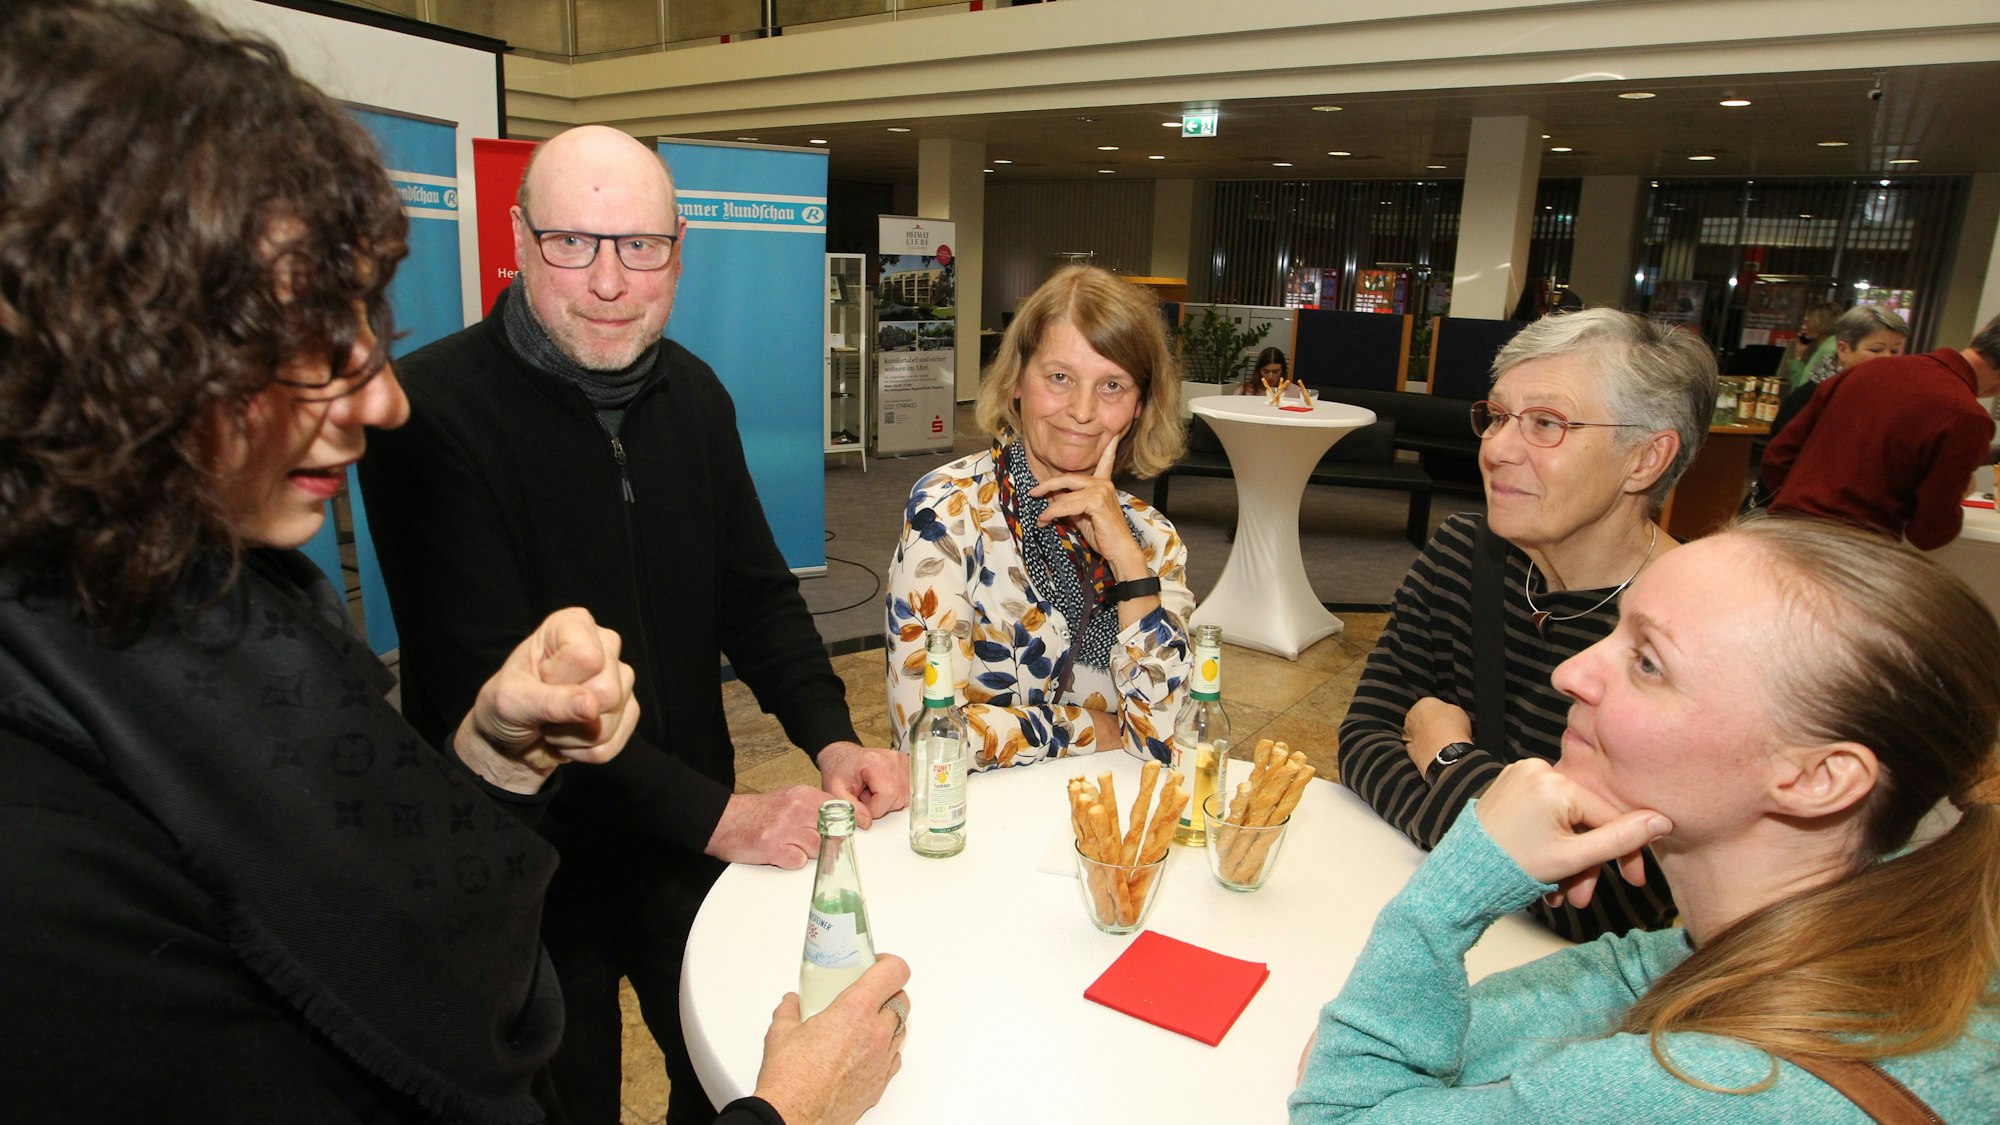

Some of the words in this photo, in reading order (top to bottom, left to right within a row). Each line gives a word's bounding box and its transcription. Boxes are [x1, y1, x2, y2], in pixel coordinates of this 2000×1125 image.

[677, 203, 719, 217] onner
[723, 202, 795, 221] Rundschau
[906, 238, 929, 246] LIEBE
[497, 267, 519, 279] Her
